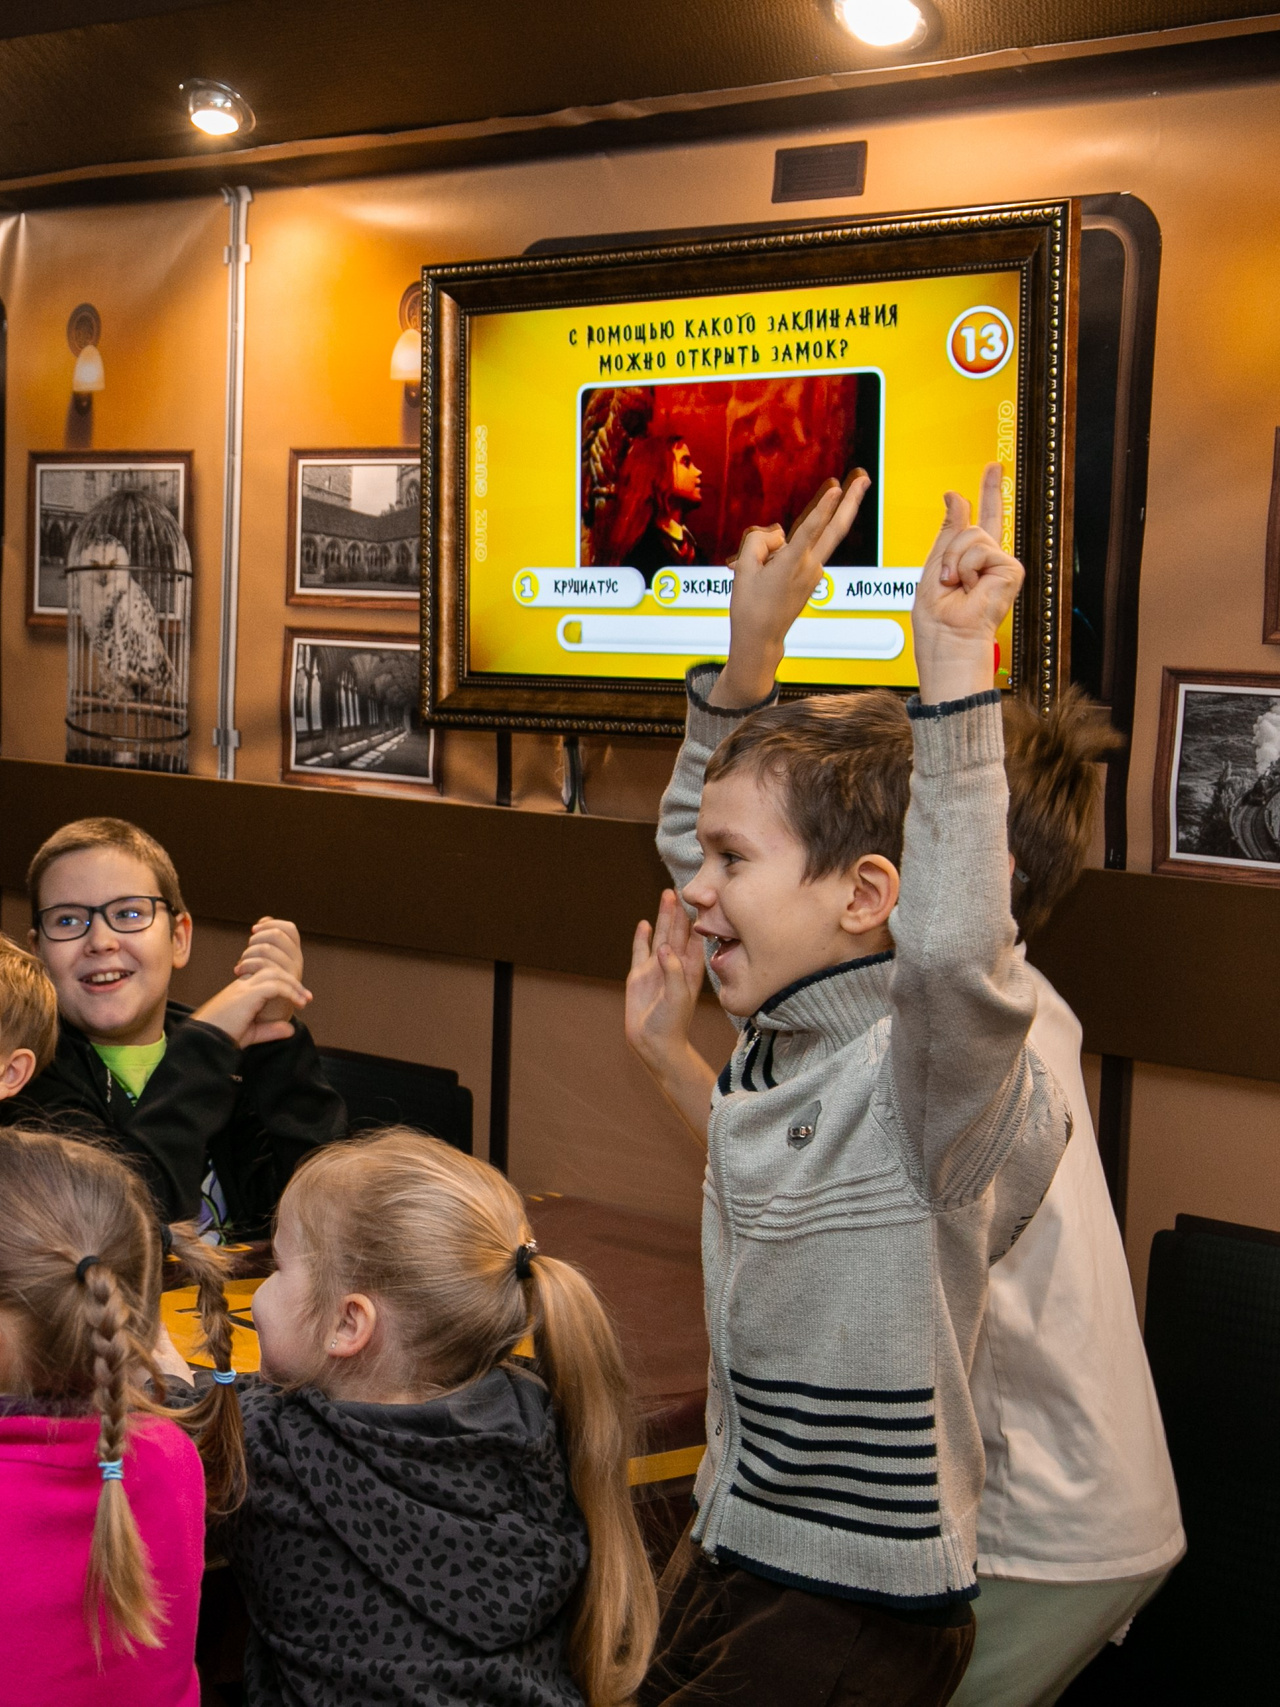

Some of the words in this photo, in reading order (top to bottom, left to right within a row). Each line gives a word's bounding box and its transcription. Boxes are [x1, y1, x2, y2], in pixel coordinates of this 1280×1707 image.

[568, 328, 578, 346] С
[586, 318, 675, 349] ПОМОЩЬЮ
[767, 303, 898, 333] ЗАКЛИНАНИЯ
[960, 322, 1005, 363] 13
[598, 350, 667, 376] МОЖНО
[676, 344, 760, 371] ОТКРЫТЬ
[771, 338, 849, 364] ЗАМОК?
[997, 400, 1015, 462] QUIZ
[475, 425, 488, 498] GUESS
[475, 509, 487, 562] QUIZ
[520, 575, 534, 598] 1
[554, 578, 619, 598] КРУЦИАТУС
[659, 574, 676, 599] 2
[846, 580, 920, 599] АЛОХОМО
